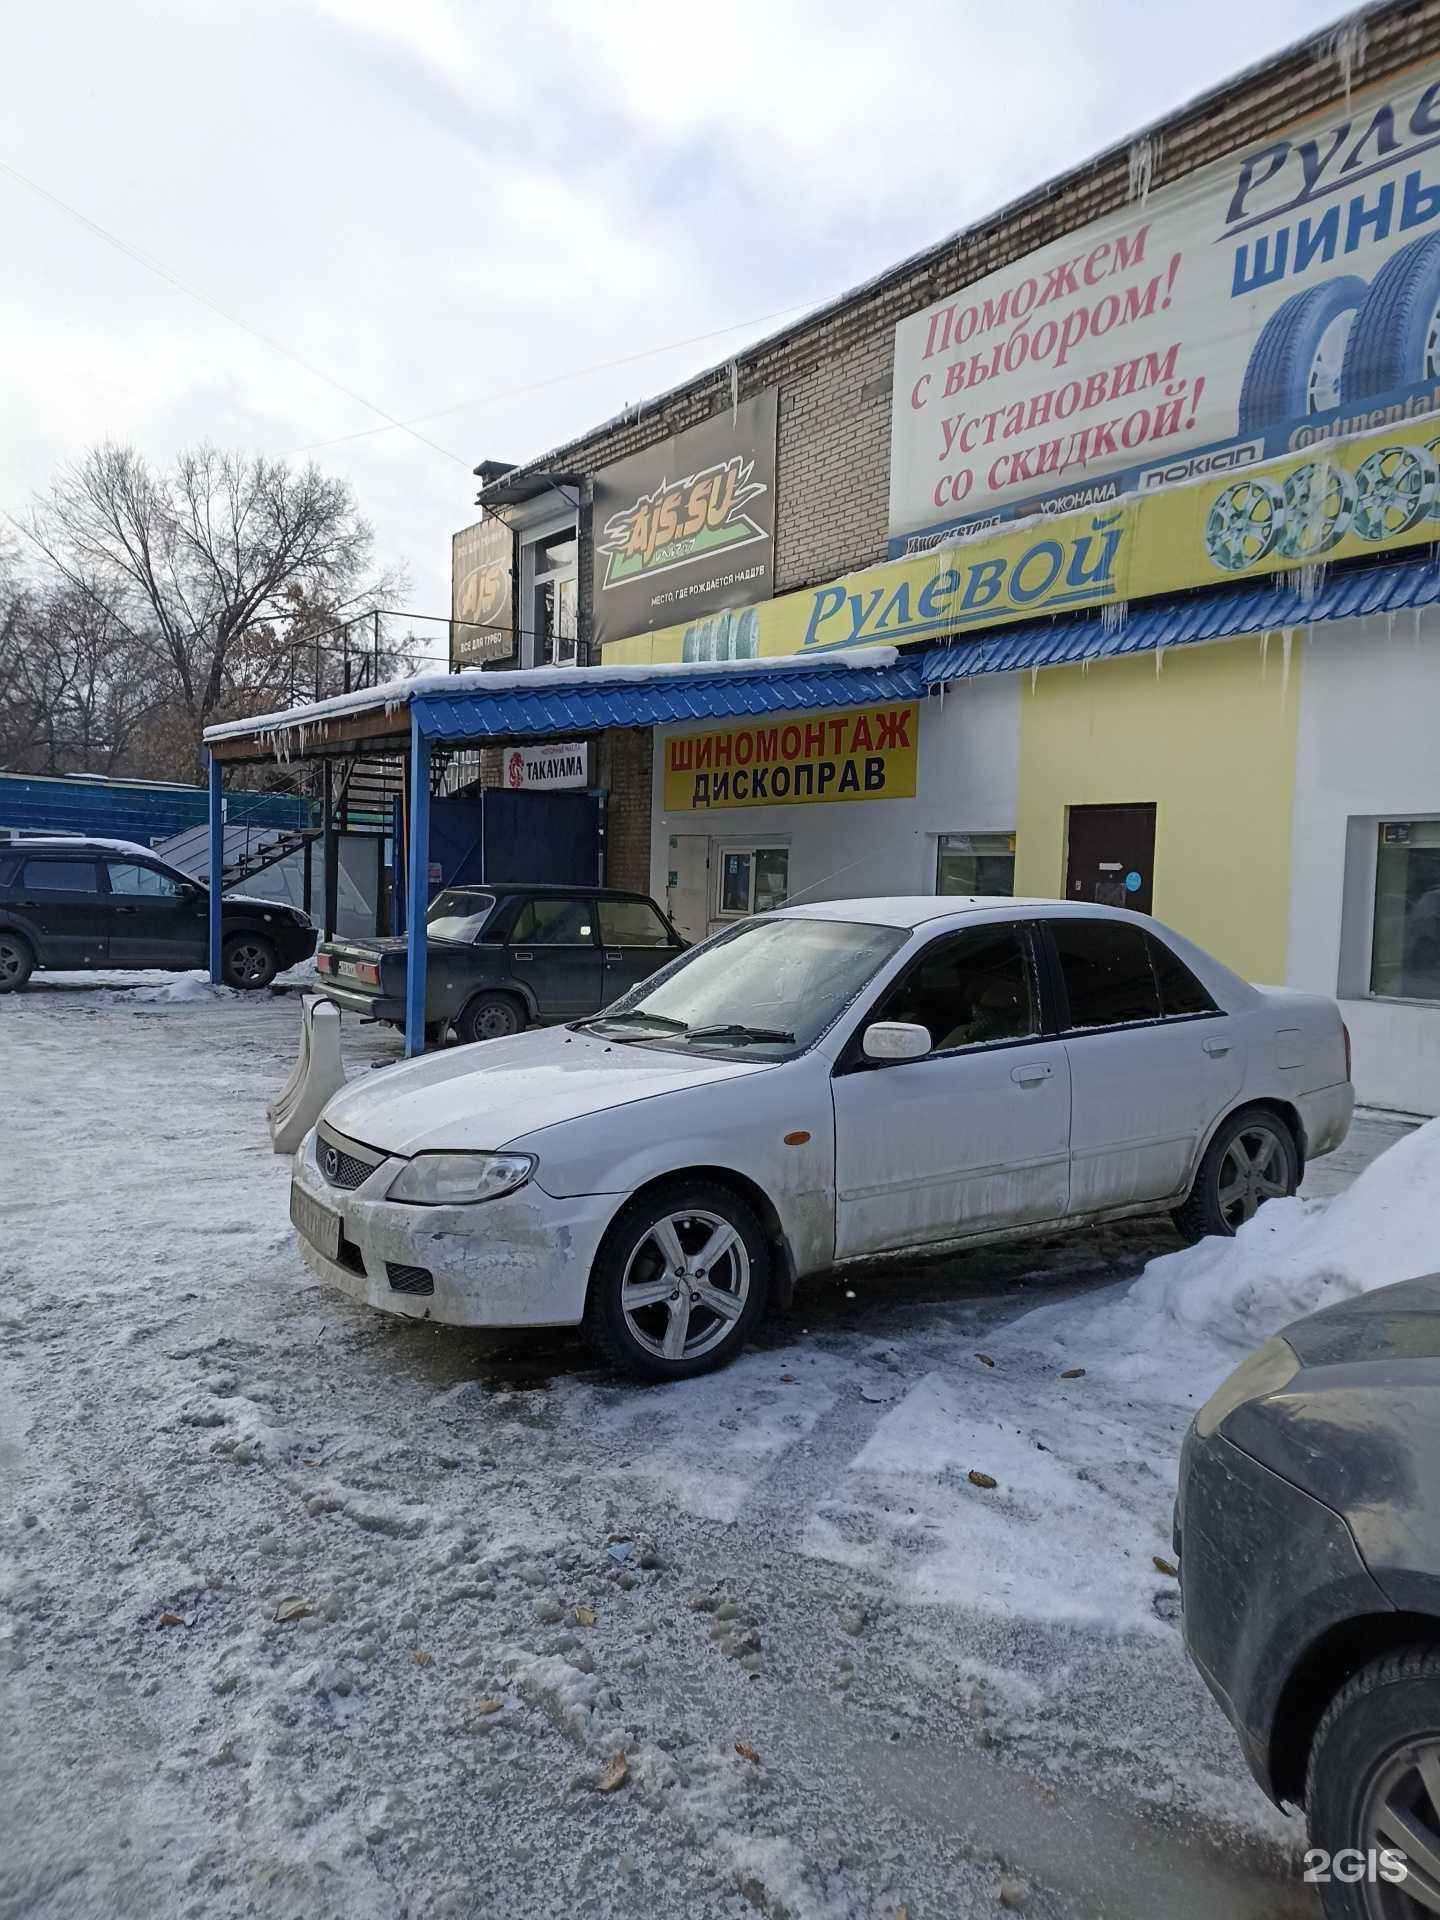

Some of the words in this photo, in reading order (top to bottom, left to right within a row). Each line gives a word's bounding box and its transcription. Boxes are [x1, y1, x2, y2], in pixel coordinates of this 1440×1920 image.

[922, 224, 1152, 360] Поможем
[911, 374, 932, 410] с
[942, 252, 1182, 398] выбором!
[934, 468, 973, 507] со
[987, 376, 1206, 491] скидкой!
[1041, 482, 1116, 513] YOKOHAMA
[675, 588, 689, 600] ГДЕ
[689, 574, 734, 596] РОЖДАЕТСЯ
[734, 565, 765, 582] НАДДУВ
[526, 756, 584, 780] TAKAYAMA
[671, 709, 912, 772] ШИНОМОНТАЖ
[692, 757, 886, 808] ДИСКОПРАВ
